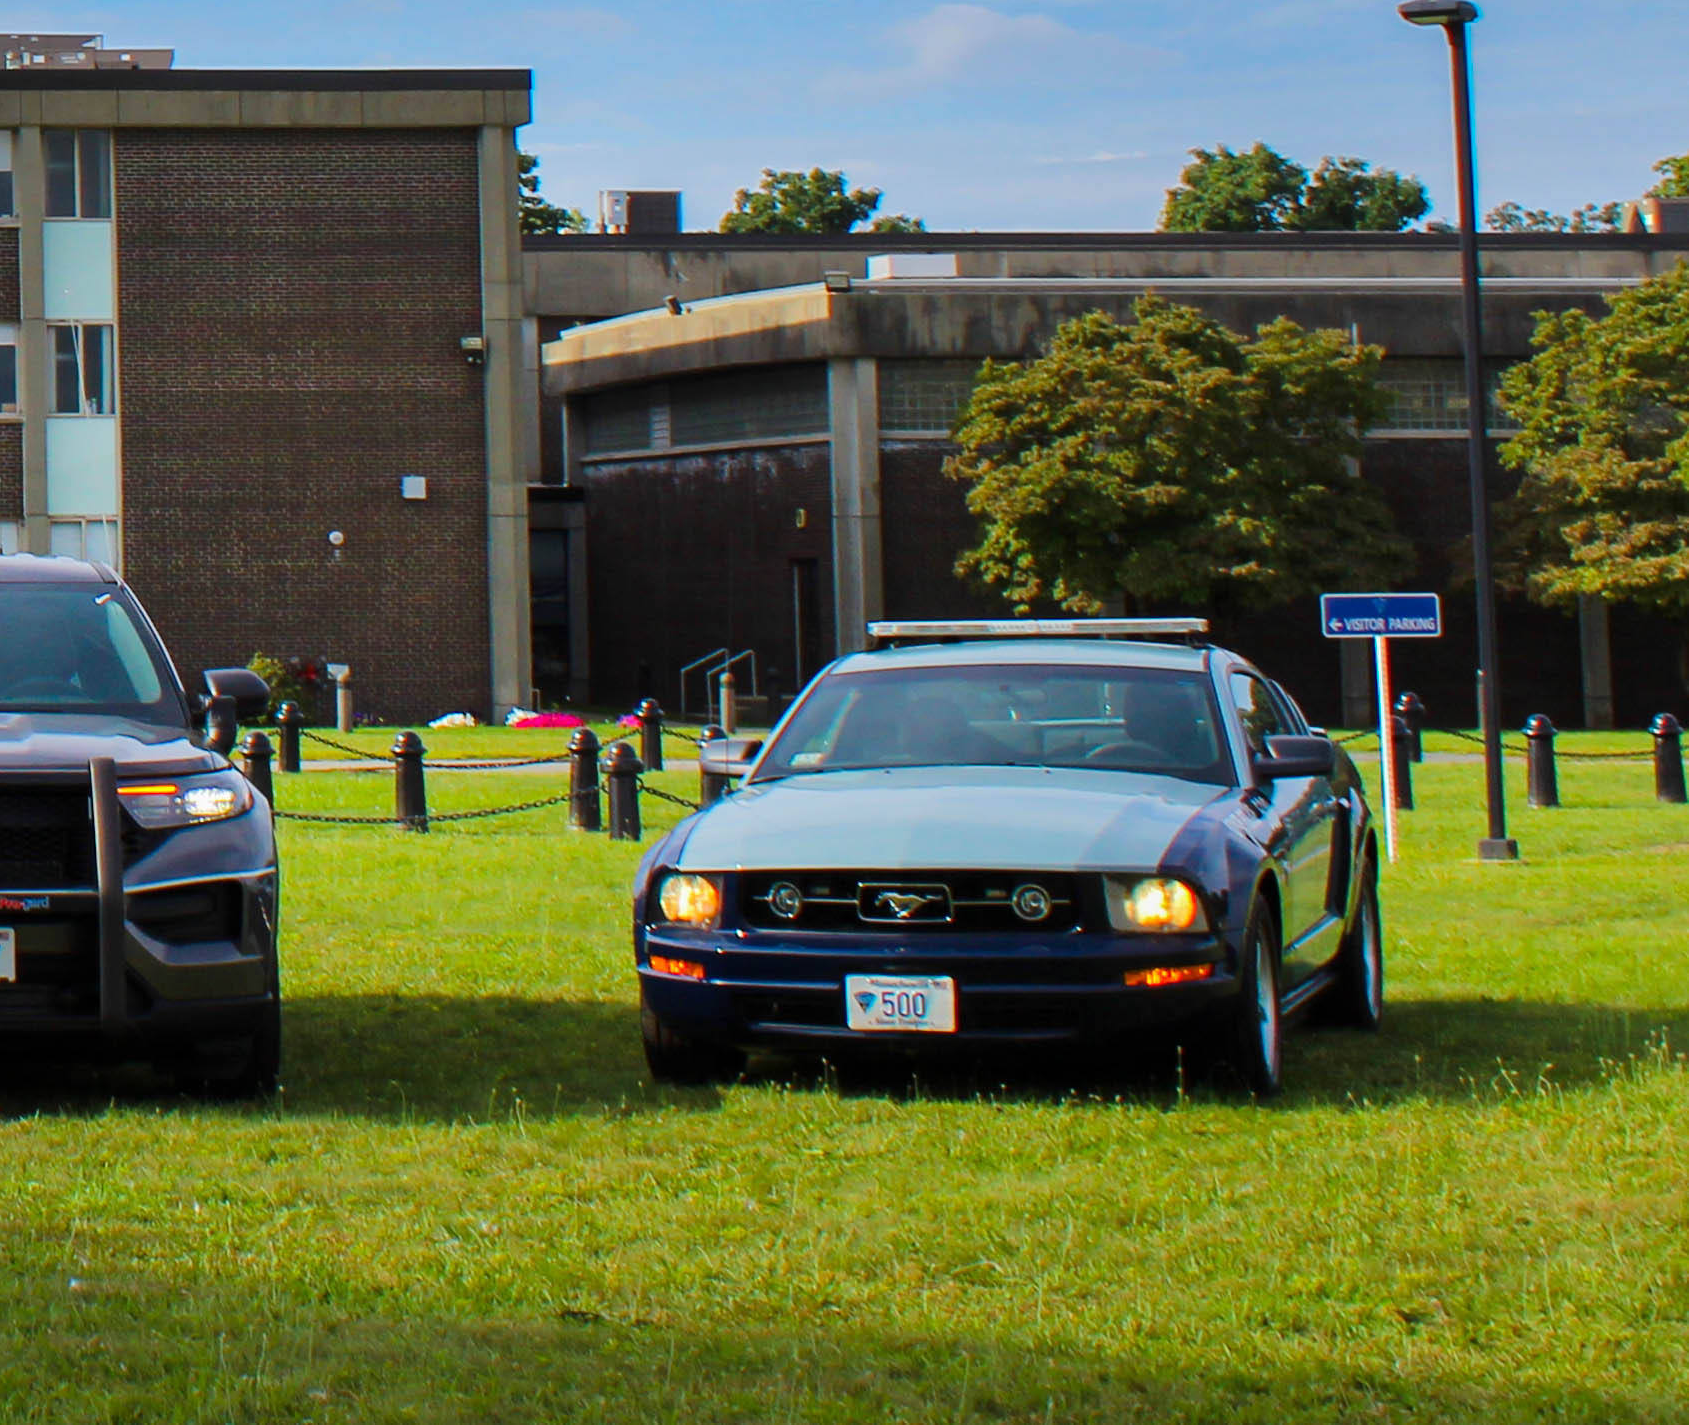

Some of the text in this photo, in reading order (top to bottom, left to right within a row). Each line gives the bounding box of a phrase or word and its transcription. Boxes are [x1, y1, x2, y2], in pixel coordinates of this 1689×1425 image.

[1344, 618, 1436, 631] VISITOR PARKING
[881, 991, 927, 1018] 500
